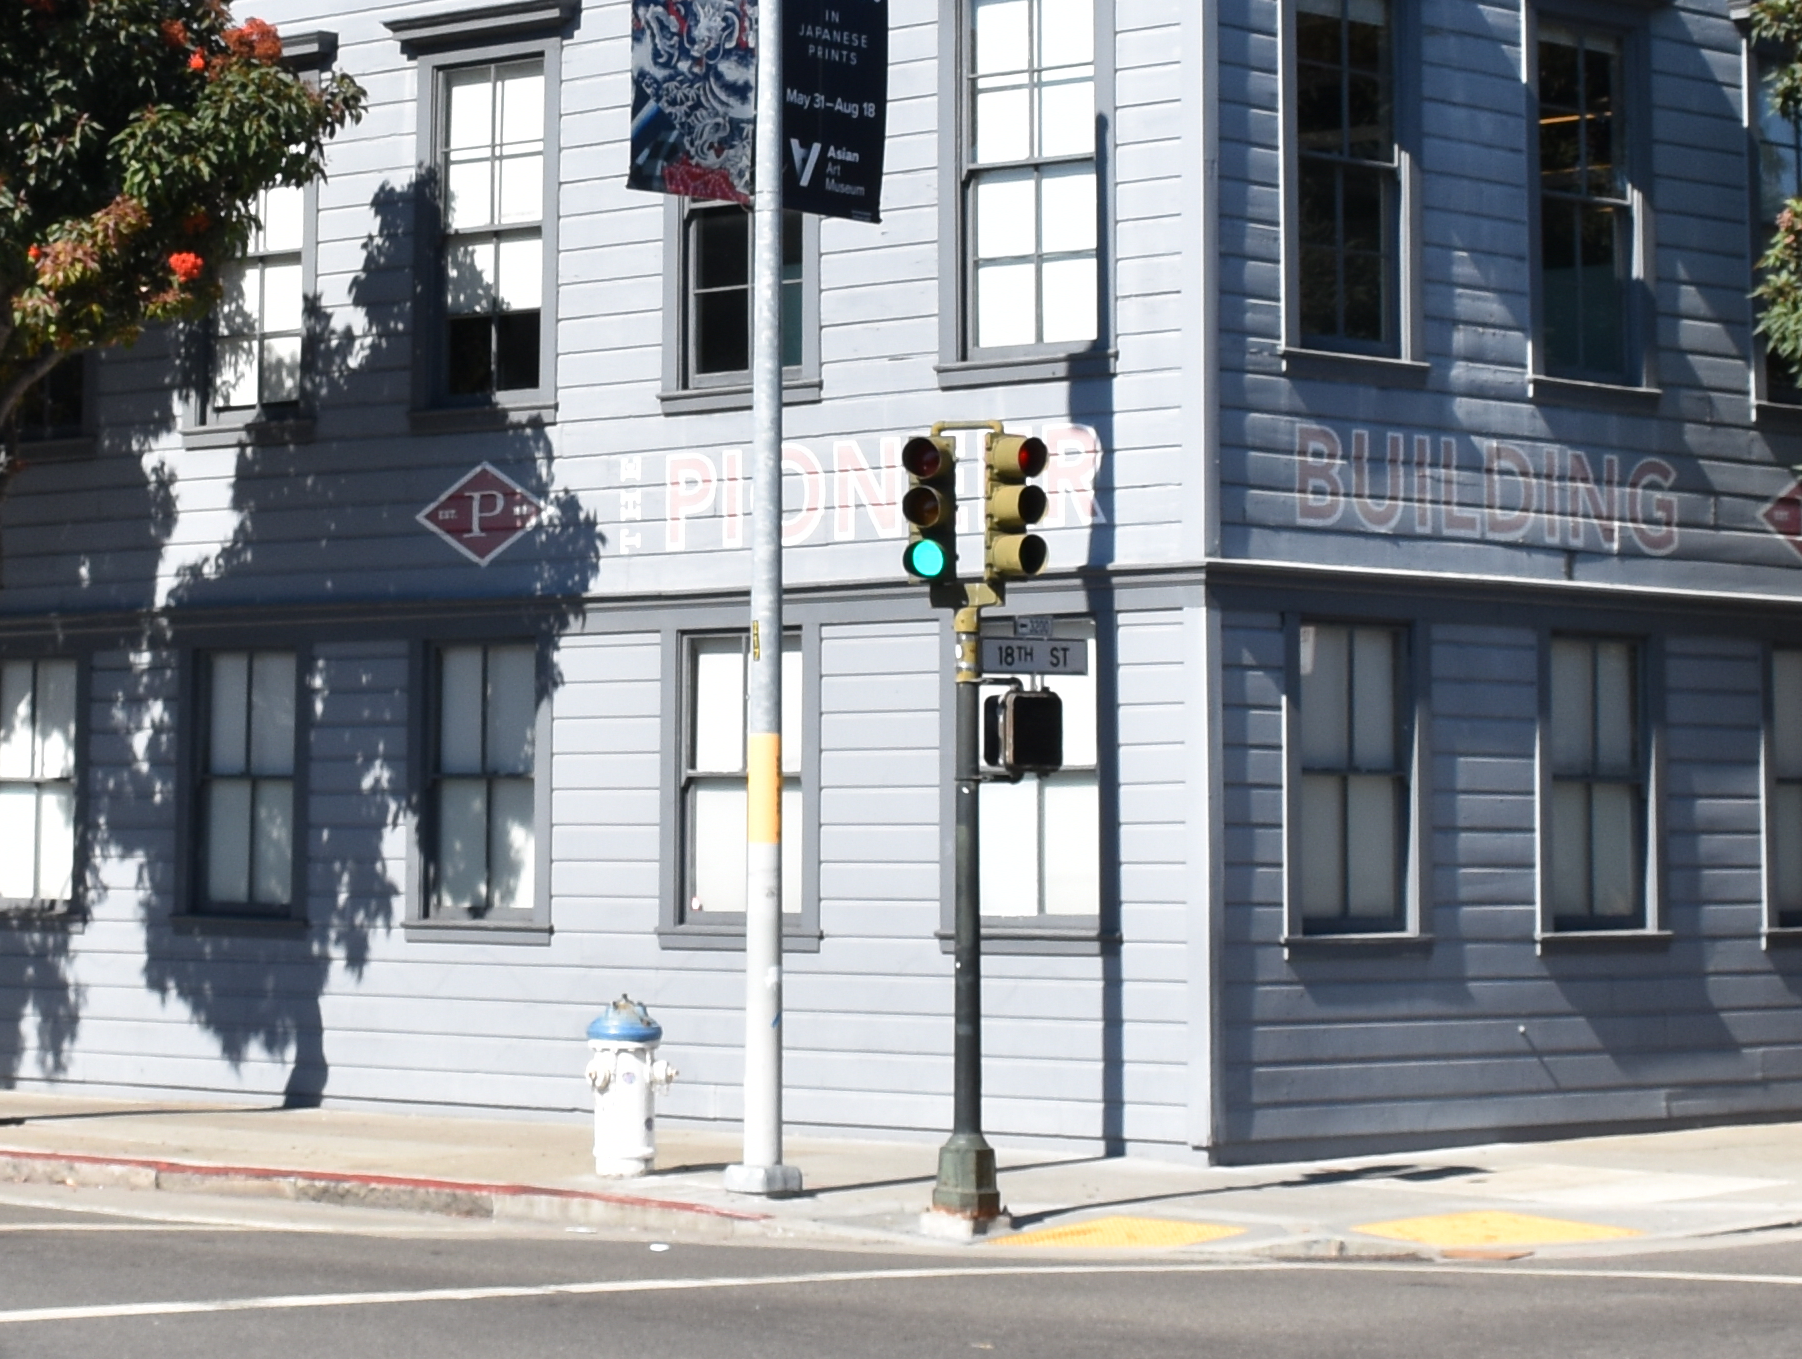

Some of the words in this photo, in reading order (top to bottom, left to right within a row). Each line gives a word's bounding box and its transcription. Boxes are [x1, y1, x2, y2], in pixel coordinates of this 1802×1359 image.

[825, 9, 840, 23] IN
[799, 24, 868, 48] JAPANESE
[808, 44, 857, 66] PRINTS
[786, 88, 811, 110] May
[863, 102, 876, 118] 18
[827, 145, 859, 162] Asian
[826, 162, 841, 177] Art
[825, 177, 865, 196] Museum
[666, 422, 1107, 552] PIONR
[1296, 424, 1679, 556] BUILDING
[463, 490, 505, 538] P
[998, 645, 1034, 667] 18TH
[1049, 646, 1070, 668] ST
